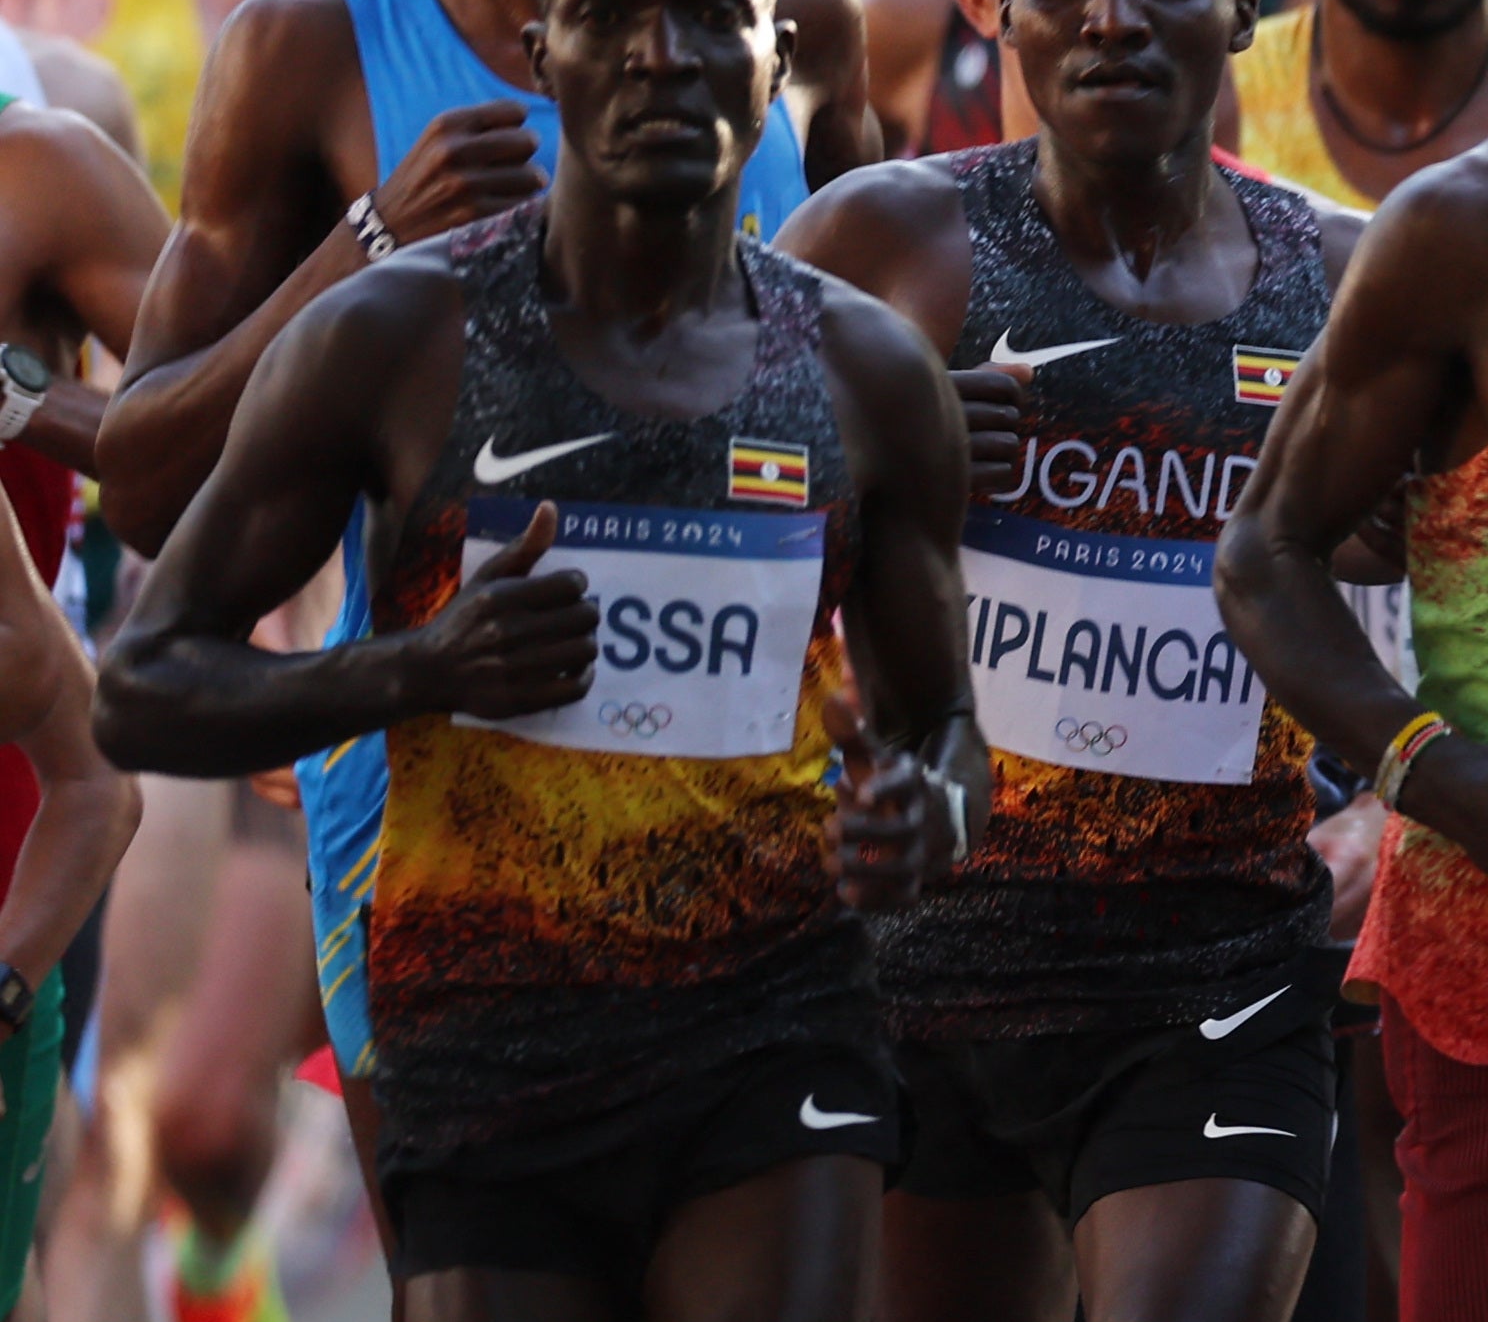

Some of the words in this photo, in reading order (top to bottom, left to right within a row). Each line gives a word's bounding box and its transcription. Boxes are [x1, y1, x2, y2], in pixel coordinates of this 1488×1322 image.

[564, 515, 650, 541] PARIS
[662, 521, 742, 548] 2024
[1036, 535, 1119, 567] PARIS
[1131, 550, 1204, 576] 2024
